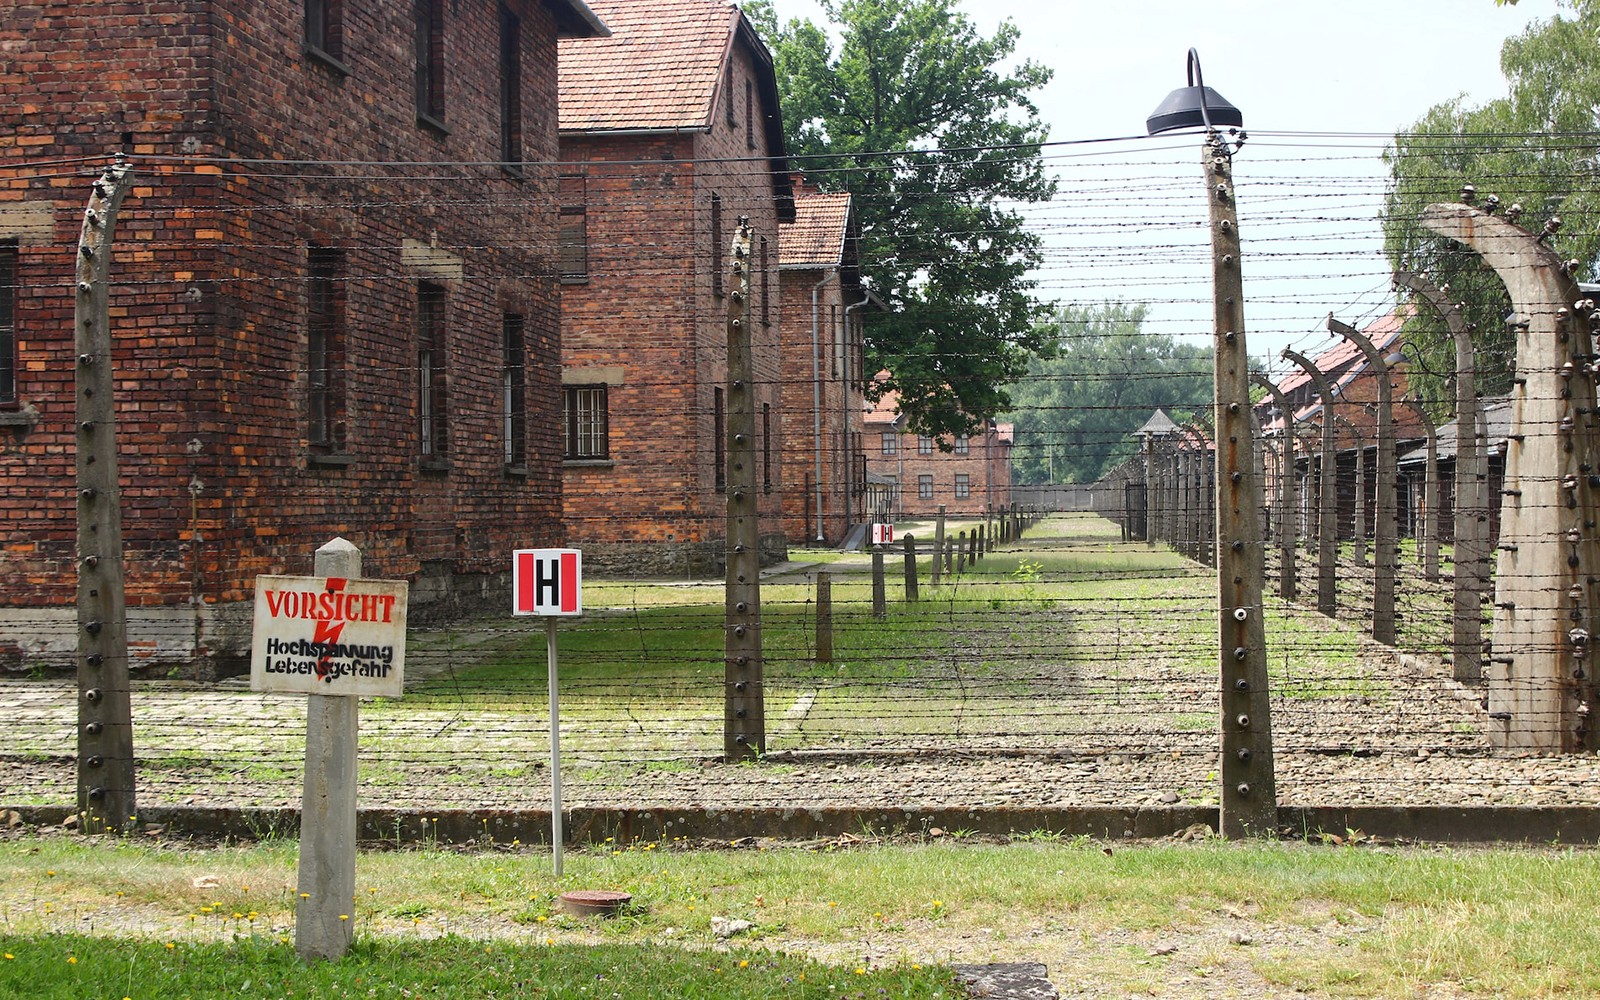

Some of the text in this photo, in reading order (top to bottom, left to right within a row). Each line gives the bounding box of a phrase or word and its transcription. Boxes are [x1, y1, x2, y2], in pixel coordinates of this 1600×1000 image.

[536, 559, 559, 606] H
[265, 590, 395, 623] VORSICHT
[267, 638, 393, 663] Hochspannung
[265, 656, 392, 679] Lebensgefahr
